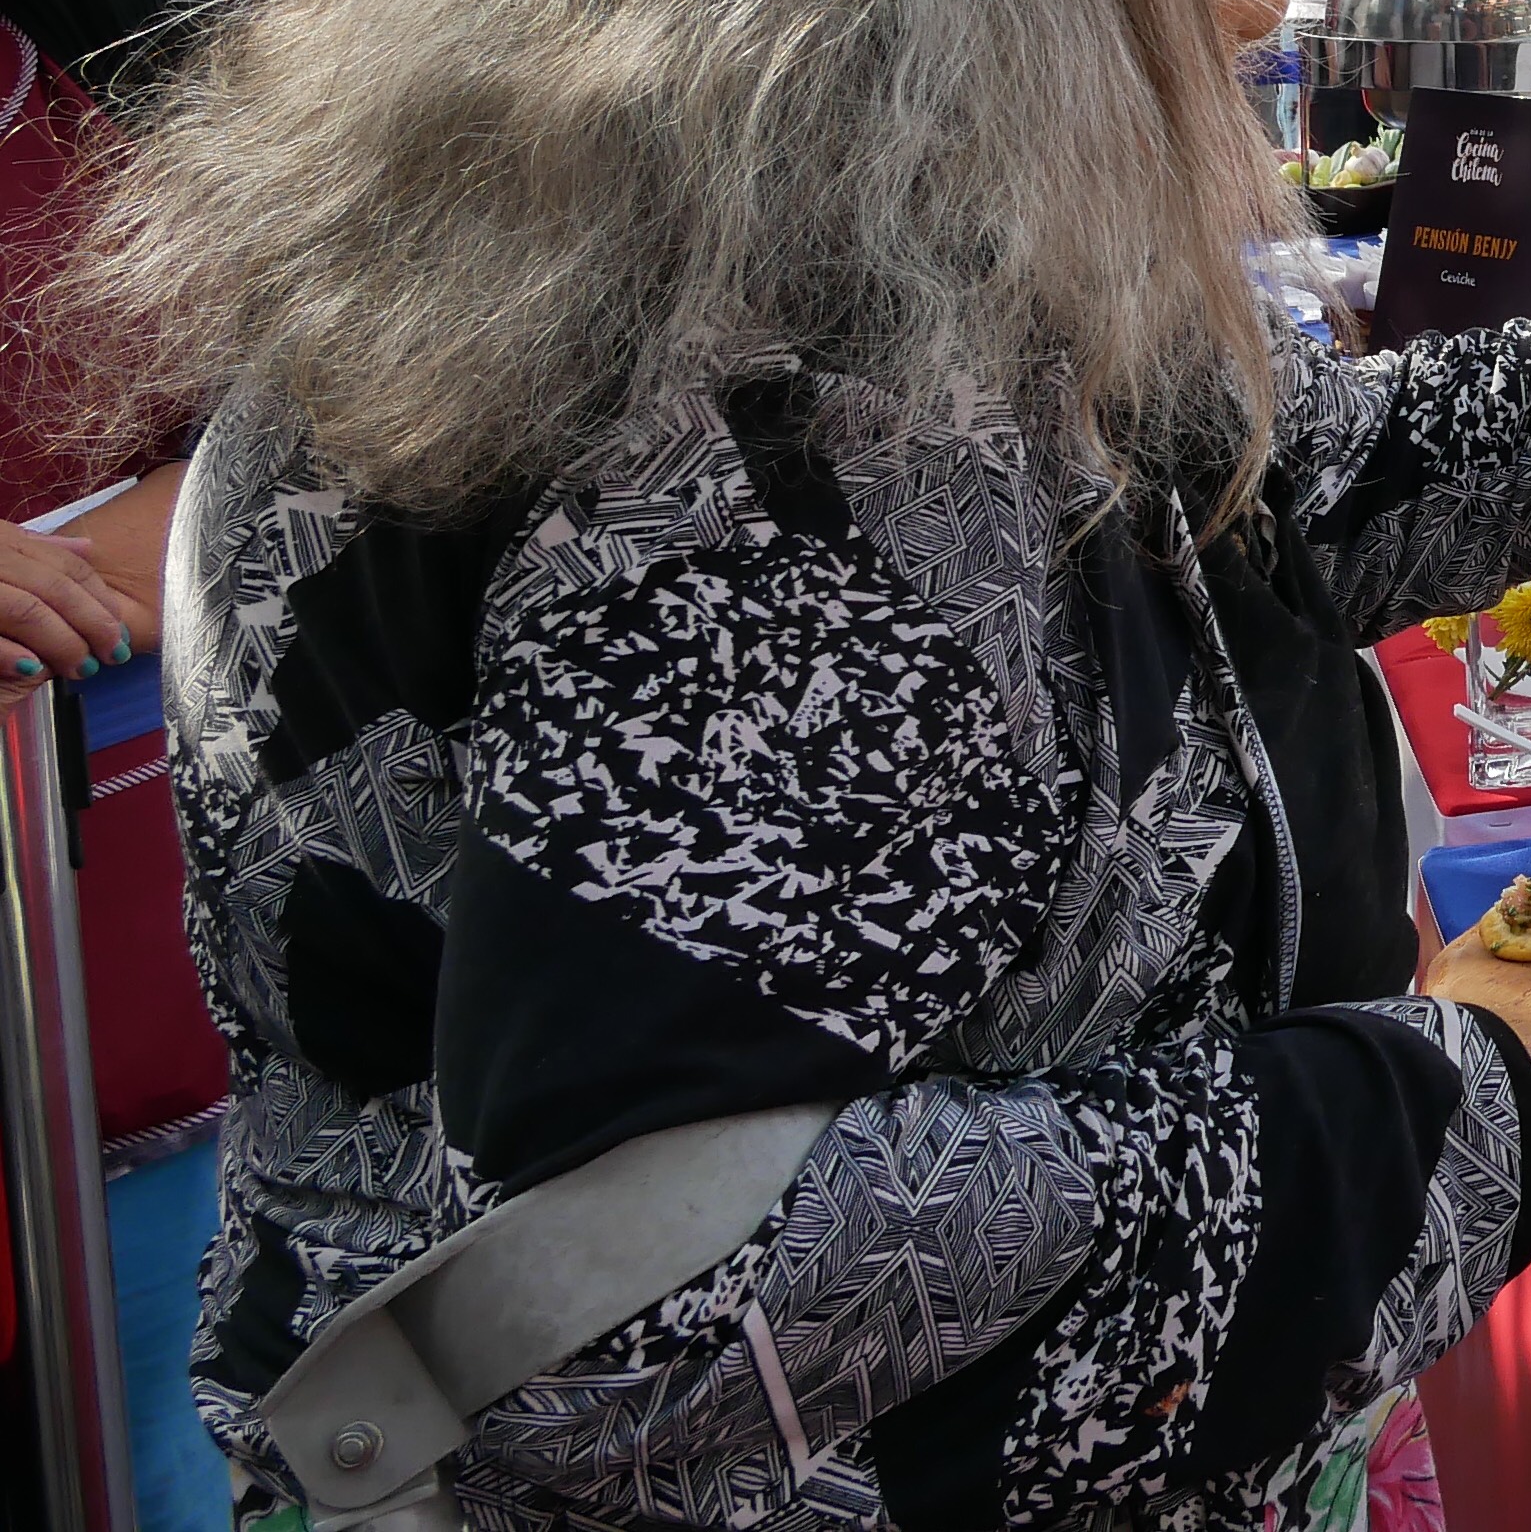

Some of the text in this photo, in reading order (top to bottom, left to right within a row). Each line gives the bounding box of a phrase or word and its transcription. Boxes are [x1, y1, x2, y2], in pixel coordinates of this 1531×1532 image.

[1456, 132, 1504, 162] Cocina
[1451, 156, 1503, 186] Chilena
[1413, 226, 1518, 260] PENSIÓN BENJY
[1440, 269, 1476, 287] Ceviche
